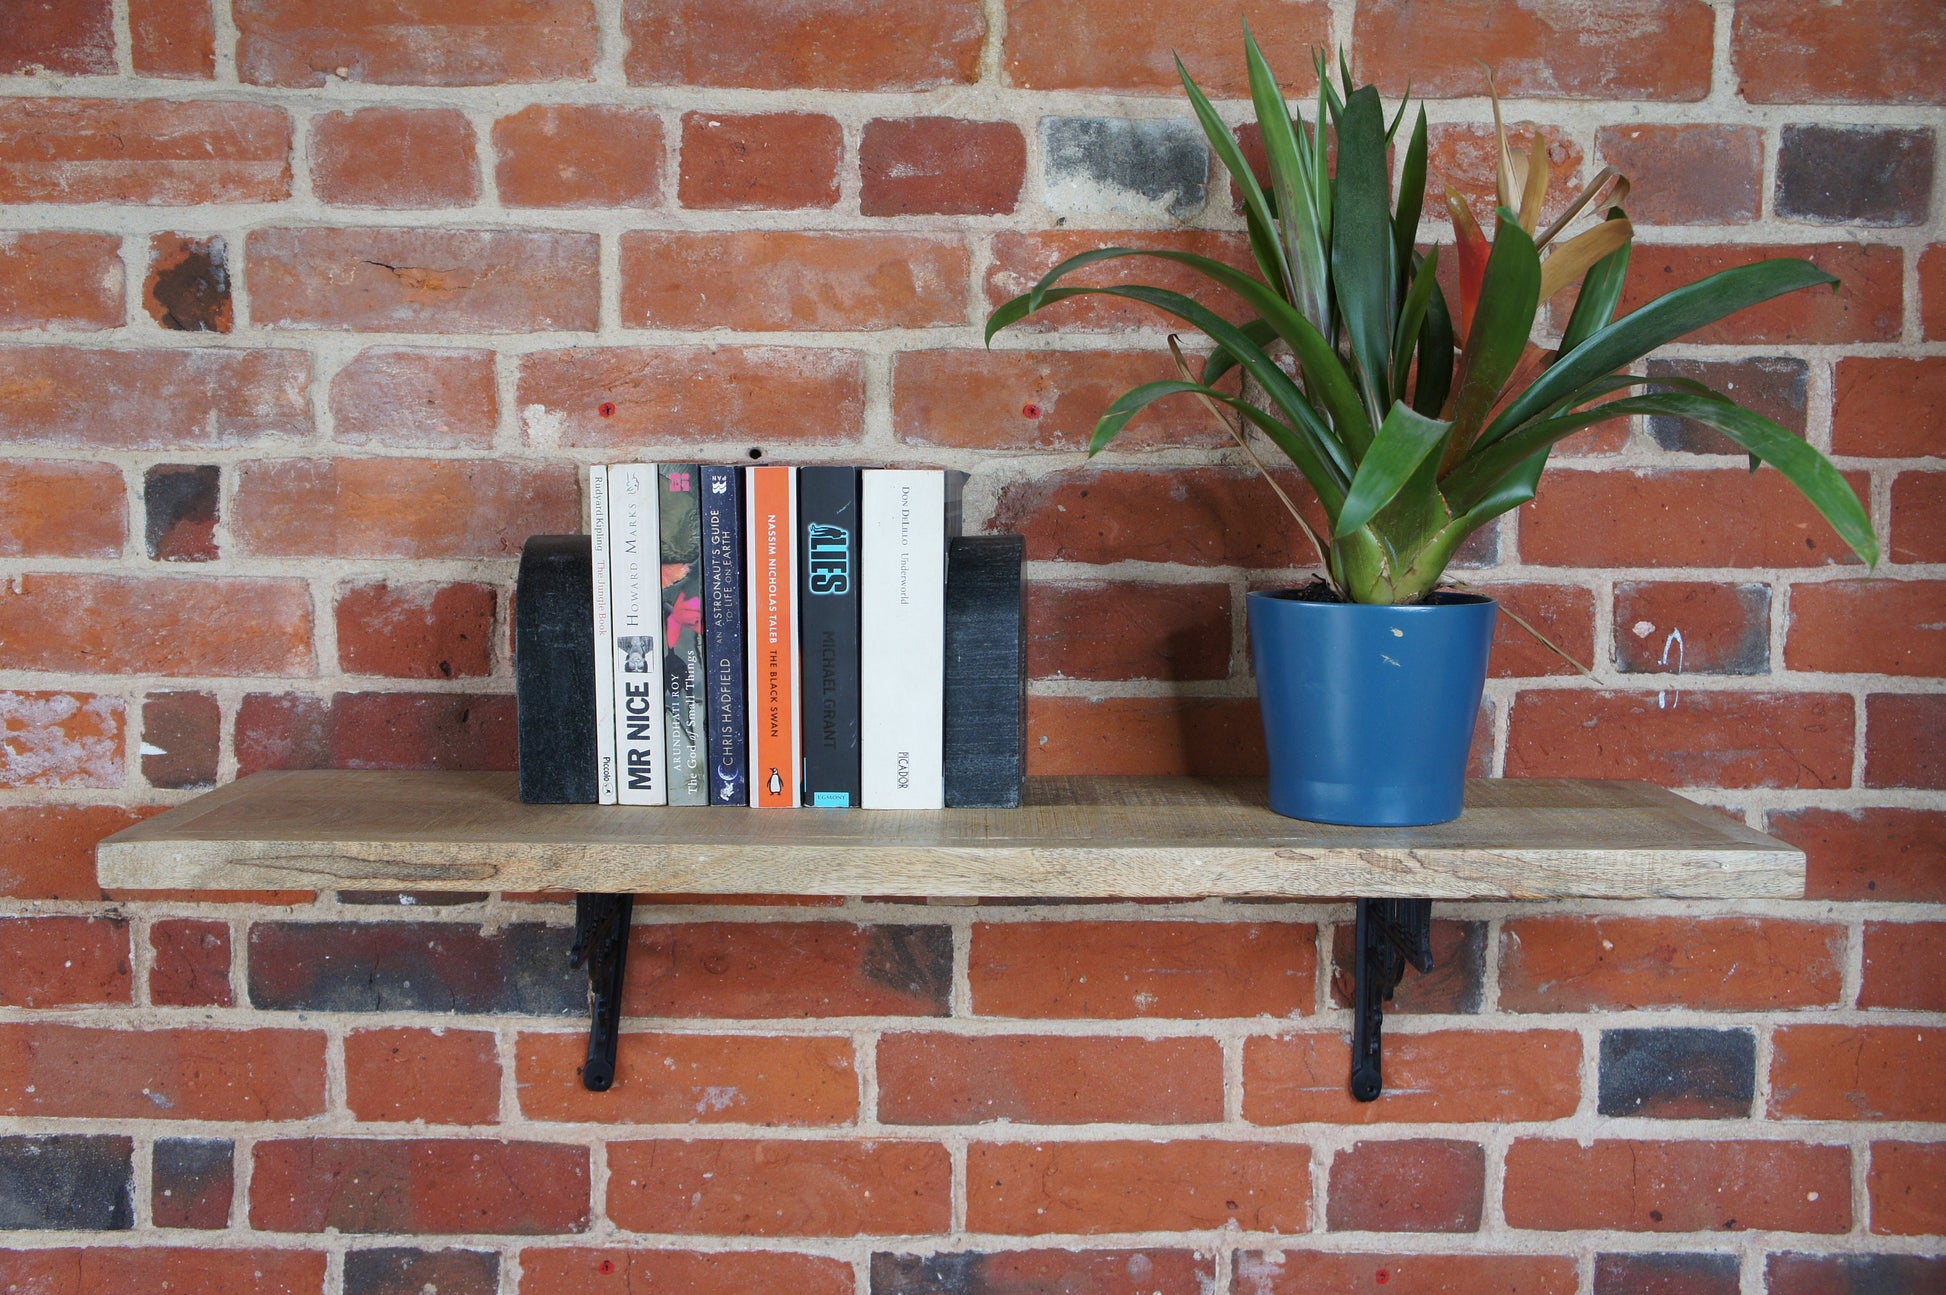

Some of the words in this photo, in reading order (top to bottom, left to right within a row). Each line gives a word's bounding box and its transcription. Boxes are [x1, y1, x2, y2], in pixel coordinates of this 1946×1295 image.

[594, 477, 604, 517] Rudyard
[901, 486, 910, 507] DON
[594, 517, 605, 552] Kipling
[625, 503, 637, 554] MARKS
[710, 509, 721, 545] GUIDE
[768, 515, 777, 555] NASSIM
[722, 530, 733, 567] EARTH
[809, 537, 850, 595] LIES
[597, 560, 606, 579] The
[724, 569, 732, 583] ON
[769, 558, 778, 612] NICHOLAS
[900, 552, 910, 606] Underworld
[597, 580, 606, 612] Jungle
[627, 562, 640, 627] HOWARD
[710, 550, 723, 627] ASTRONAUT'S
[724, 586, 734, 607] LIFE
[598, 613, 607, 636] Book
[726, 610, 734, 623] TO
[769, 615, 779, 645] TALEB
[715, 629, 724, 644] AN
[685, 650, 696, 691] Things
[769, 650, 778, 668] THE
[822, 629, 836, 694] MICHAEL
[671, 674, 679, 697] ROY
[720, 658, 732, 722] HADFIELD
[769, 671, 778, 703] BLACK
[625, 682, 651, 741] NICE
[686, 696, 696, 727] Small
[770, 706, 779, 738] SWAN
[823, 701, 837, 749] GRANT
[672, 701, 682, 771] ARUNDHATI
[688, 727, 699, 741] of
[721, 725, 734, 766] CHRIS
[602, 757, 611, 782] Piccolo
[627, 749, 652, 790] MR
[686, 743, 697, 769] God
[897, 751, 909, 790] PICADOR
[688, 772, 698, 795] The
